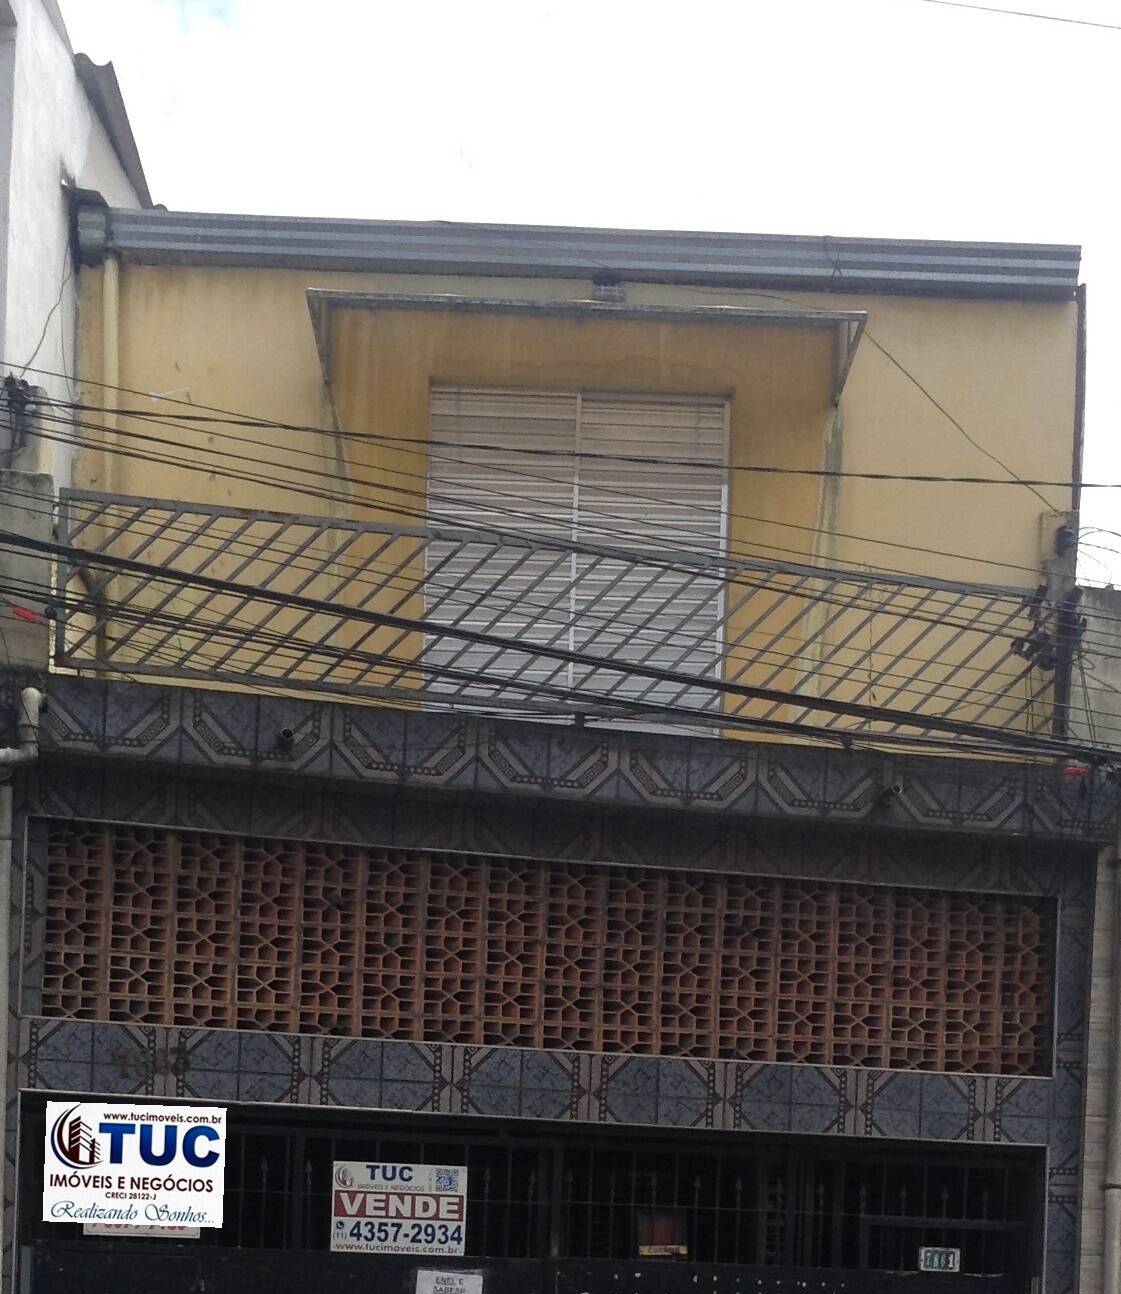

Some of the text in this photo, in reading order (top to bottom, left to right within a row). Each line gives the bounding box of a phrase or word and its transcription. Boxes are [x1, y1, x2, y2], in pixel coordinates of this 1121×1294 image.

[366, 1165, 413, 1182] TUC
[340, 1192, 460, 1219] VENDE
[333, 1221, 463, 1245] (11) 4357-2934
[335, 1243, 459, 1254] www.tucimoveis.com.br
